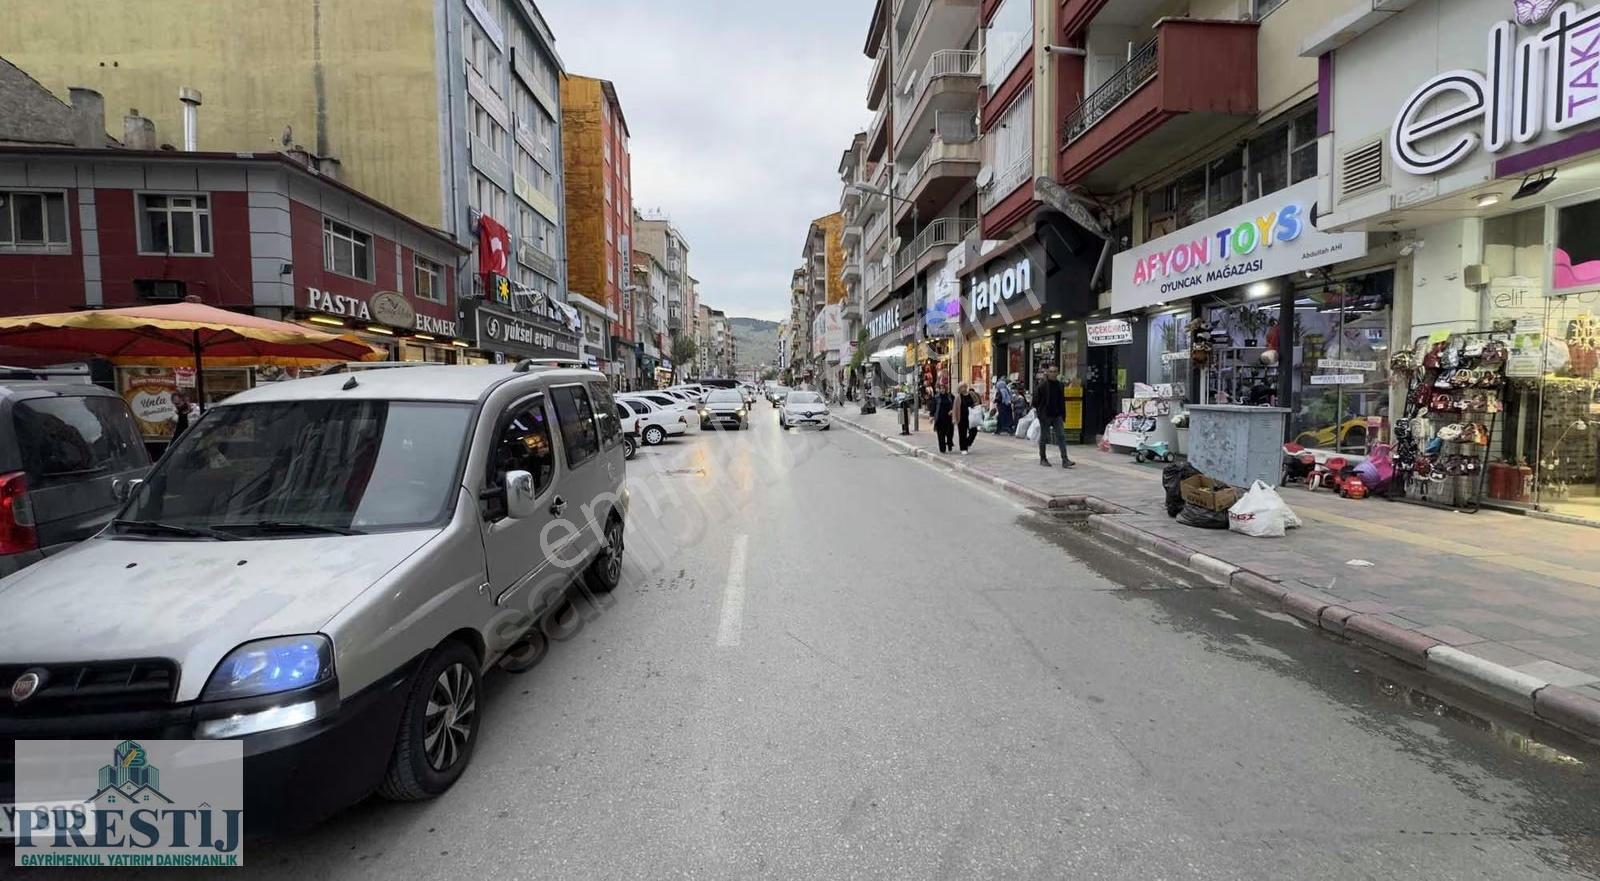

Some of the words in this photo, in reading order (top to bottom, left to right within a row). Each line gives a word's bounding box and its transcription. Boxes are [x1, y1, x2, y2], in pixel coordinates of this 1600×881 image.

[1391, 3, 1600, 175] elit
[1132, 236, 1211, 286] AFYON
[1216, 204, 1303, 260] TOYS
[970, 257, 1031, 322] japon
[1160, 275, 1203, 294] OYUNCAK
[1206, 259, 1263, 283] MAĞAZASI
[306, 287, 371, 320] PASTA
[415, 313, 457, 337] EKMEK
[503, 319, 533, 344] yüksel
